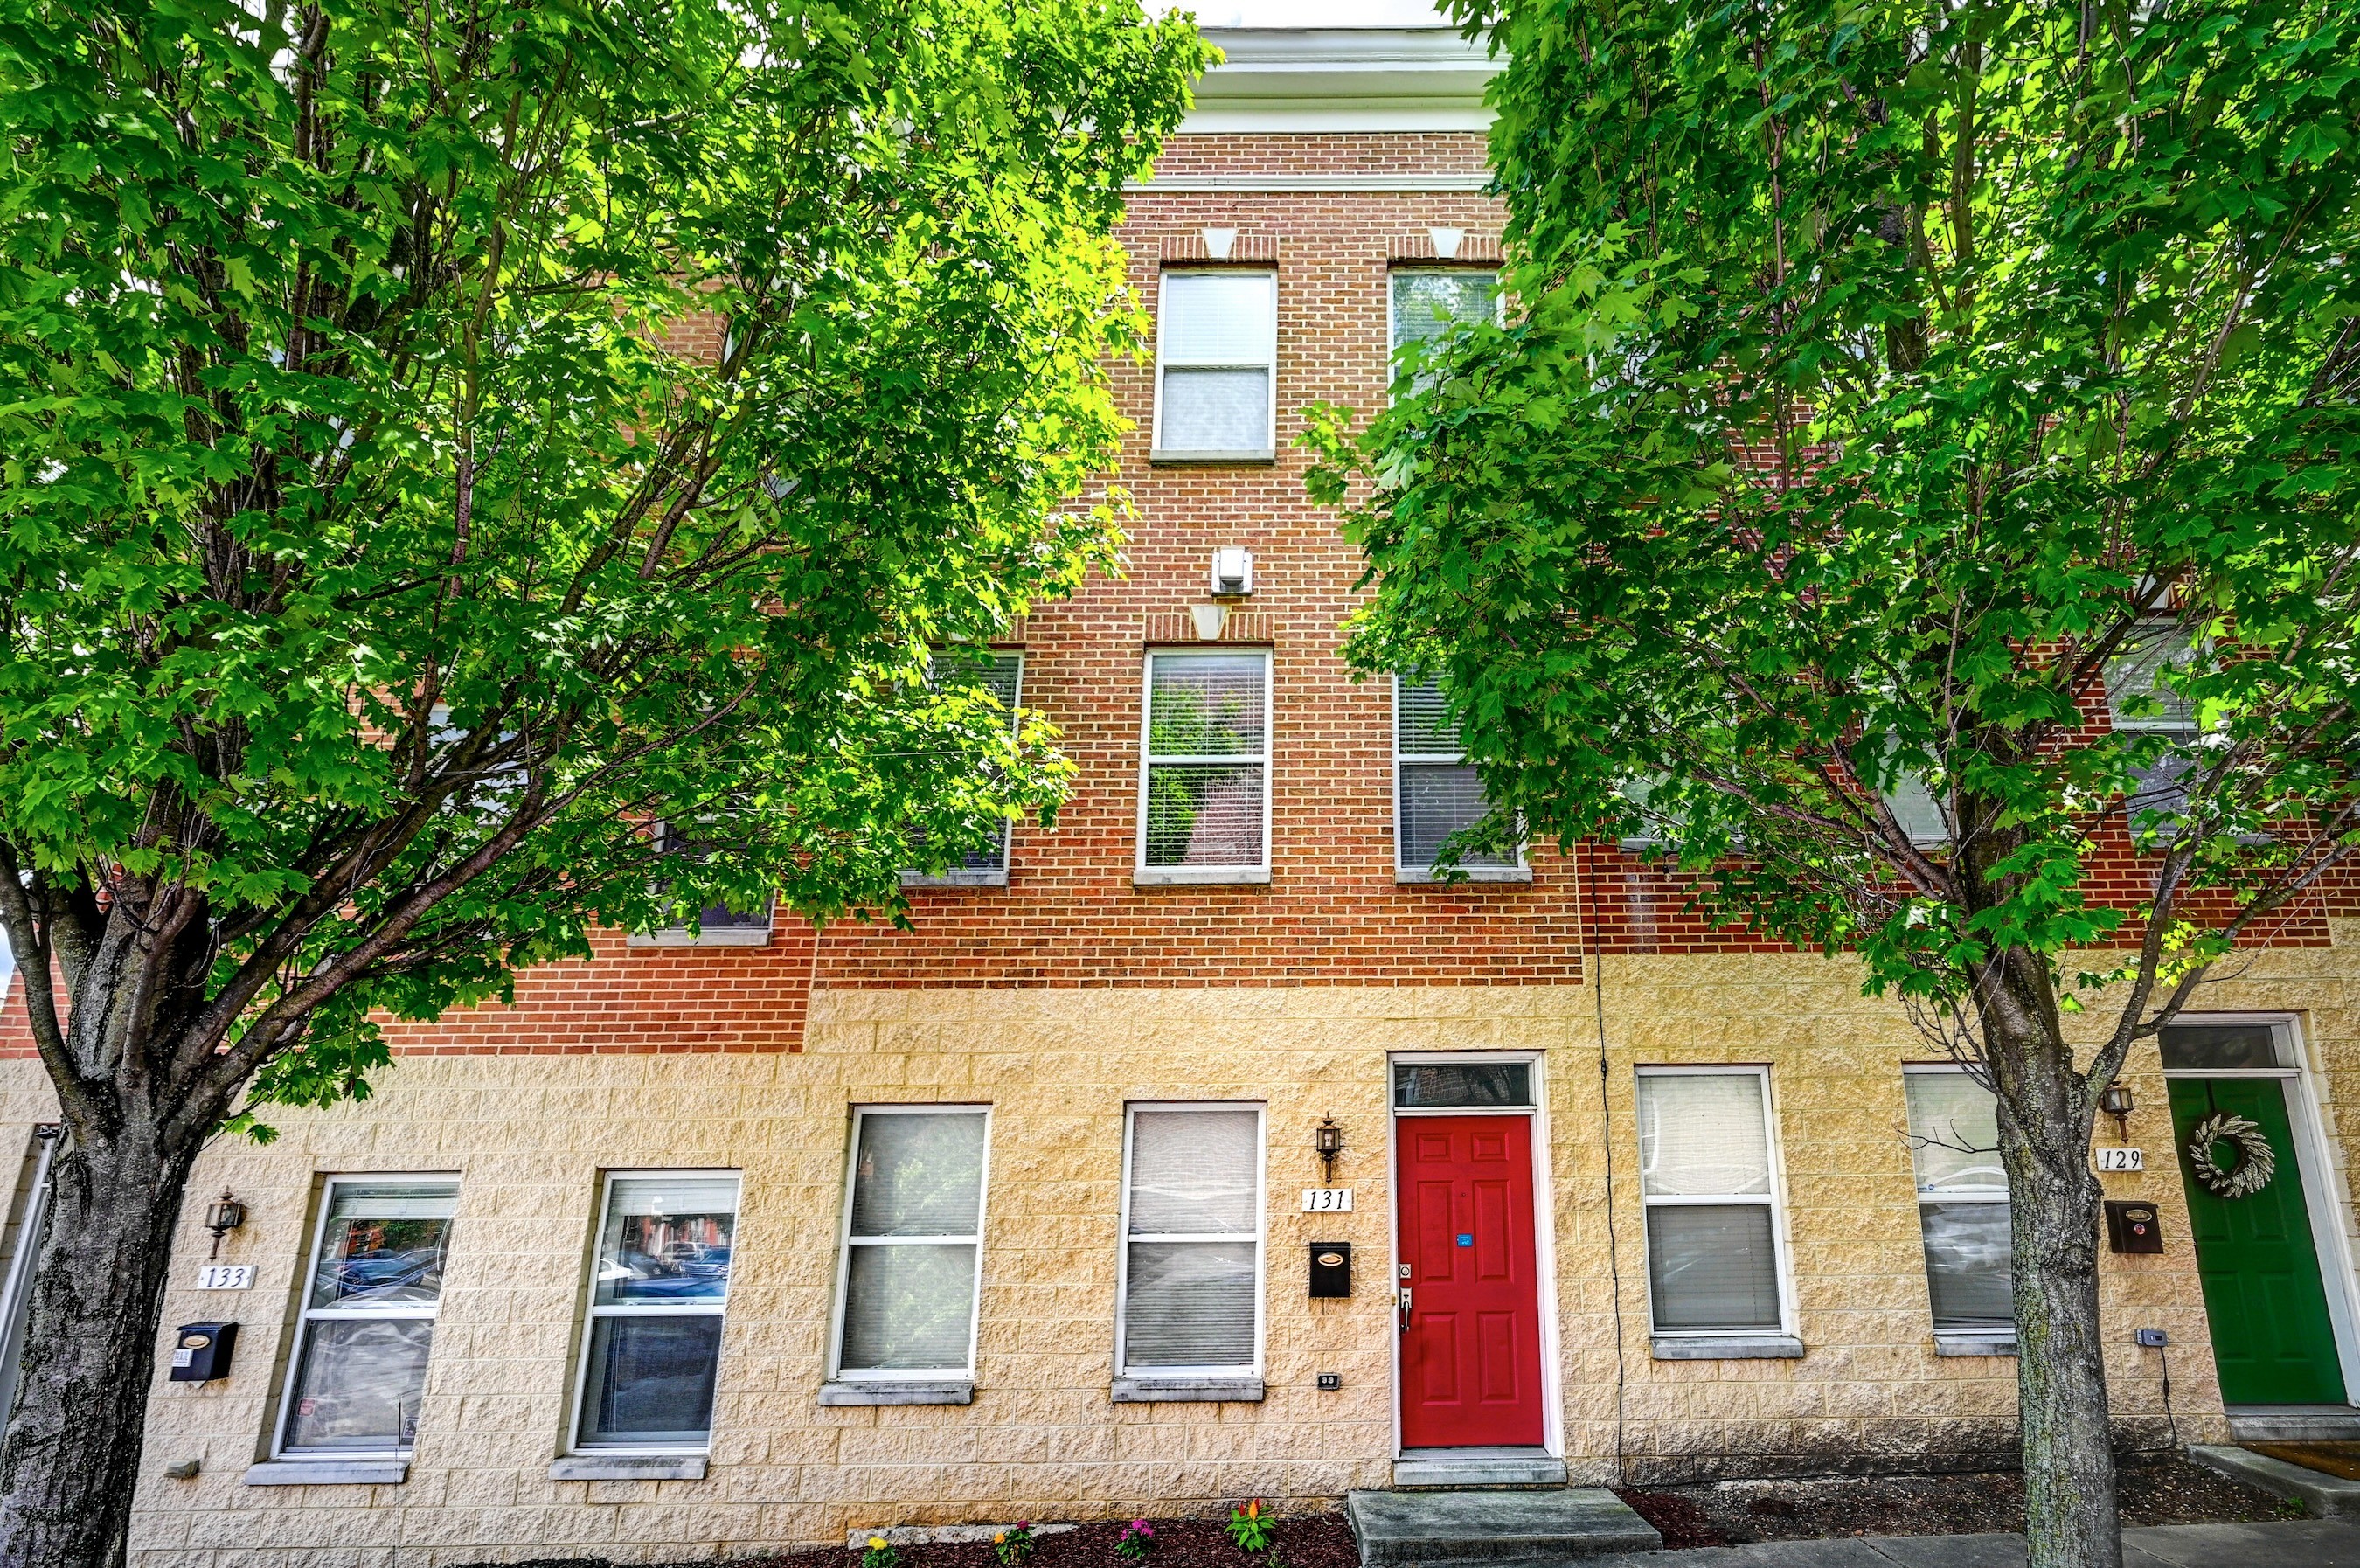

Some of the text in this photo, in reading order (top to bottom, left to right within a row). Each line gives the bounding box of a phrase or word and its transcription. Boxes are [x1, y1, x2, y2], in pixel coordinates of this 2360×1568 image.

[2105, 1150, 2140, 1169] 129
[1309, 1190, 1343, 1210] 131
[206, 1267, 245, 1287] 133
